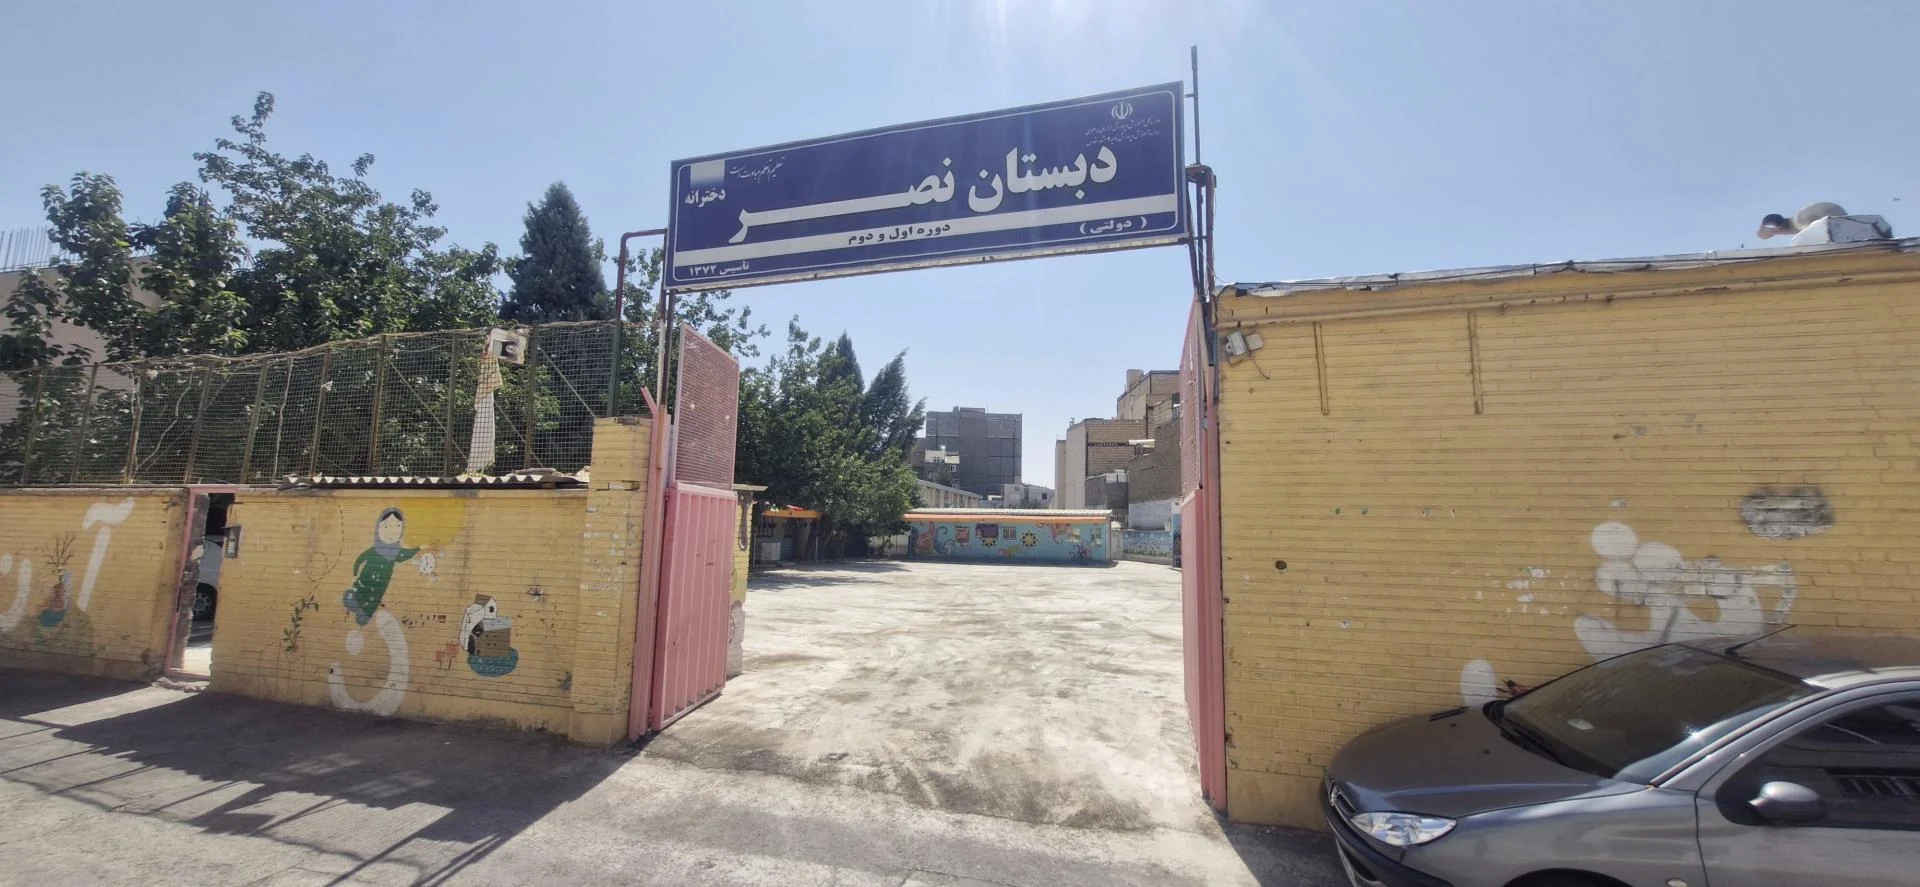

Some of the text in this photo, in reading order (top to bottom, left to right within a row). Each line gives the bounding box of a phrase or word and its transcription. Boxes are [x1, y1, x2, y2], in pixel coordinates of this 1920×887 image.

[684, 187, 726, 208] دخترانه
[728, 145, 1118, 245] دبستان نصر
[848, 223, 951, 246] دوره اول و دوم
